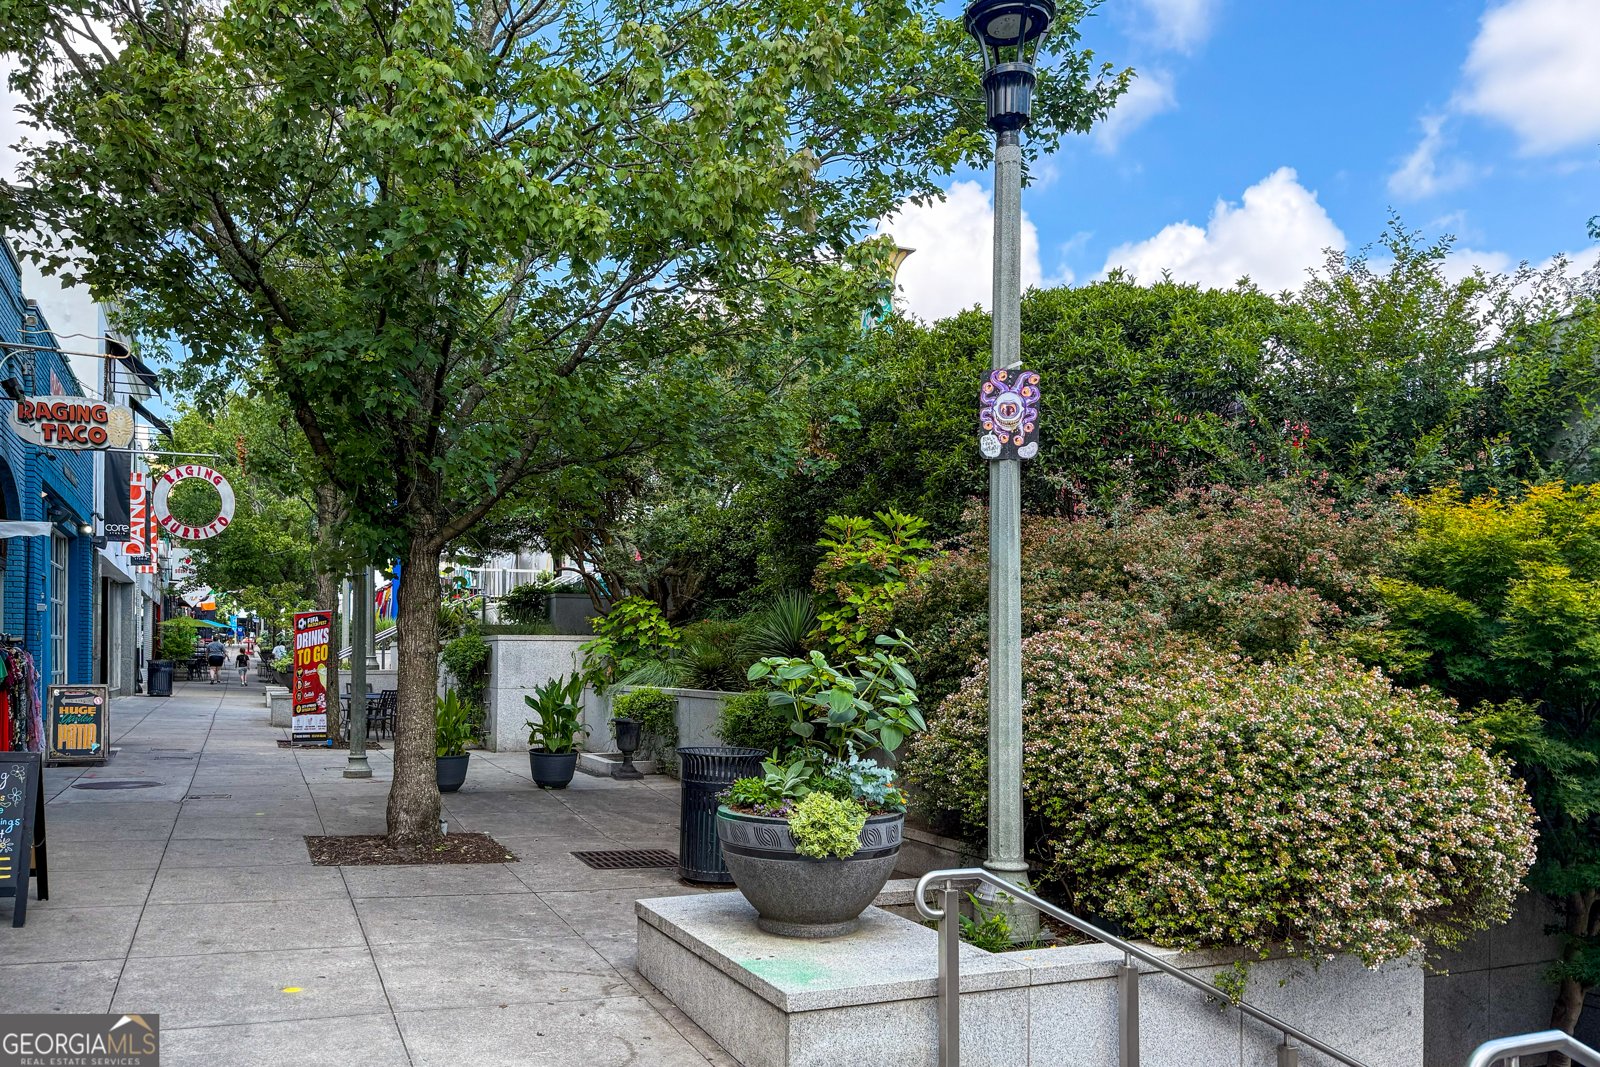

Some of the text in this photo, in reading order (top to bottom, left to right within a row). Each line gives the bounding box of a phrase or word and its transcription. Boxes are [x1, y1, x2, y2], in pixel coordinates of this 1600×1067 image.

[17, 401, 108, 423] RAGING
[41, 423, 107, 444] TACO
[163, 465, 223, 486] RAGING
[122, 472, 146, 556] DANCE
[105, 523, 130, 533] core
[161, 515, 229, 539] BURRITO
[307, 616, 319, 624] FIFA
[296, 627, 329, 650] DRINKS
[297, 644, 329, 666] TO GO
[59, 706, 96, 715] HUGE
[57, 723, 97, 750] PATIO
